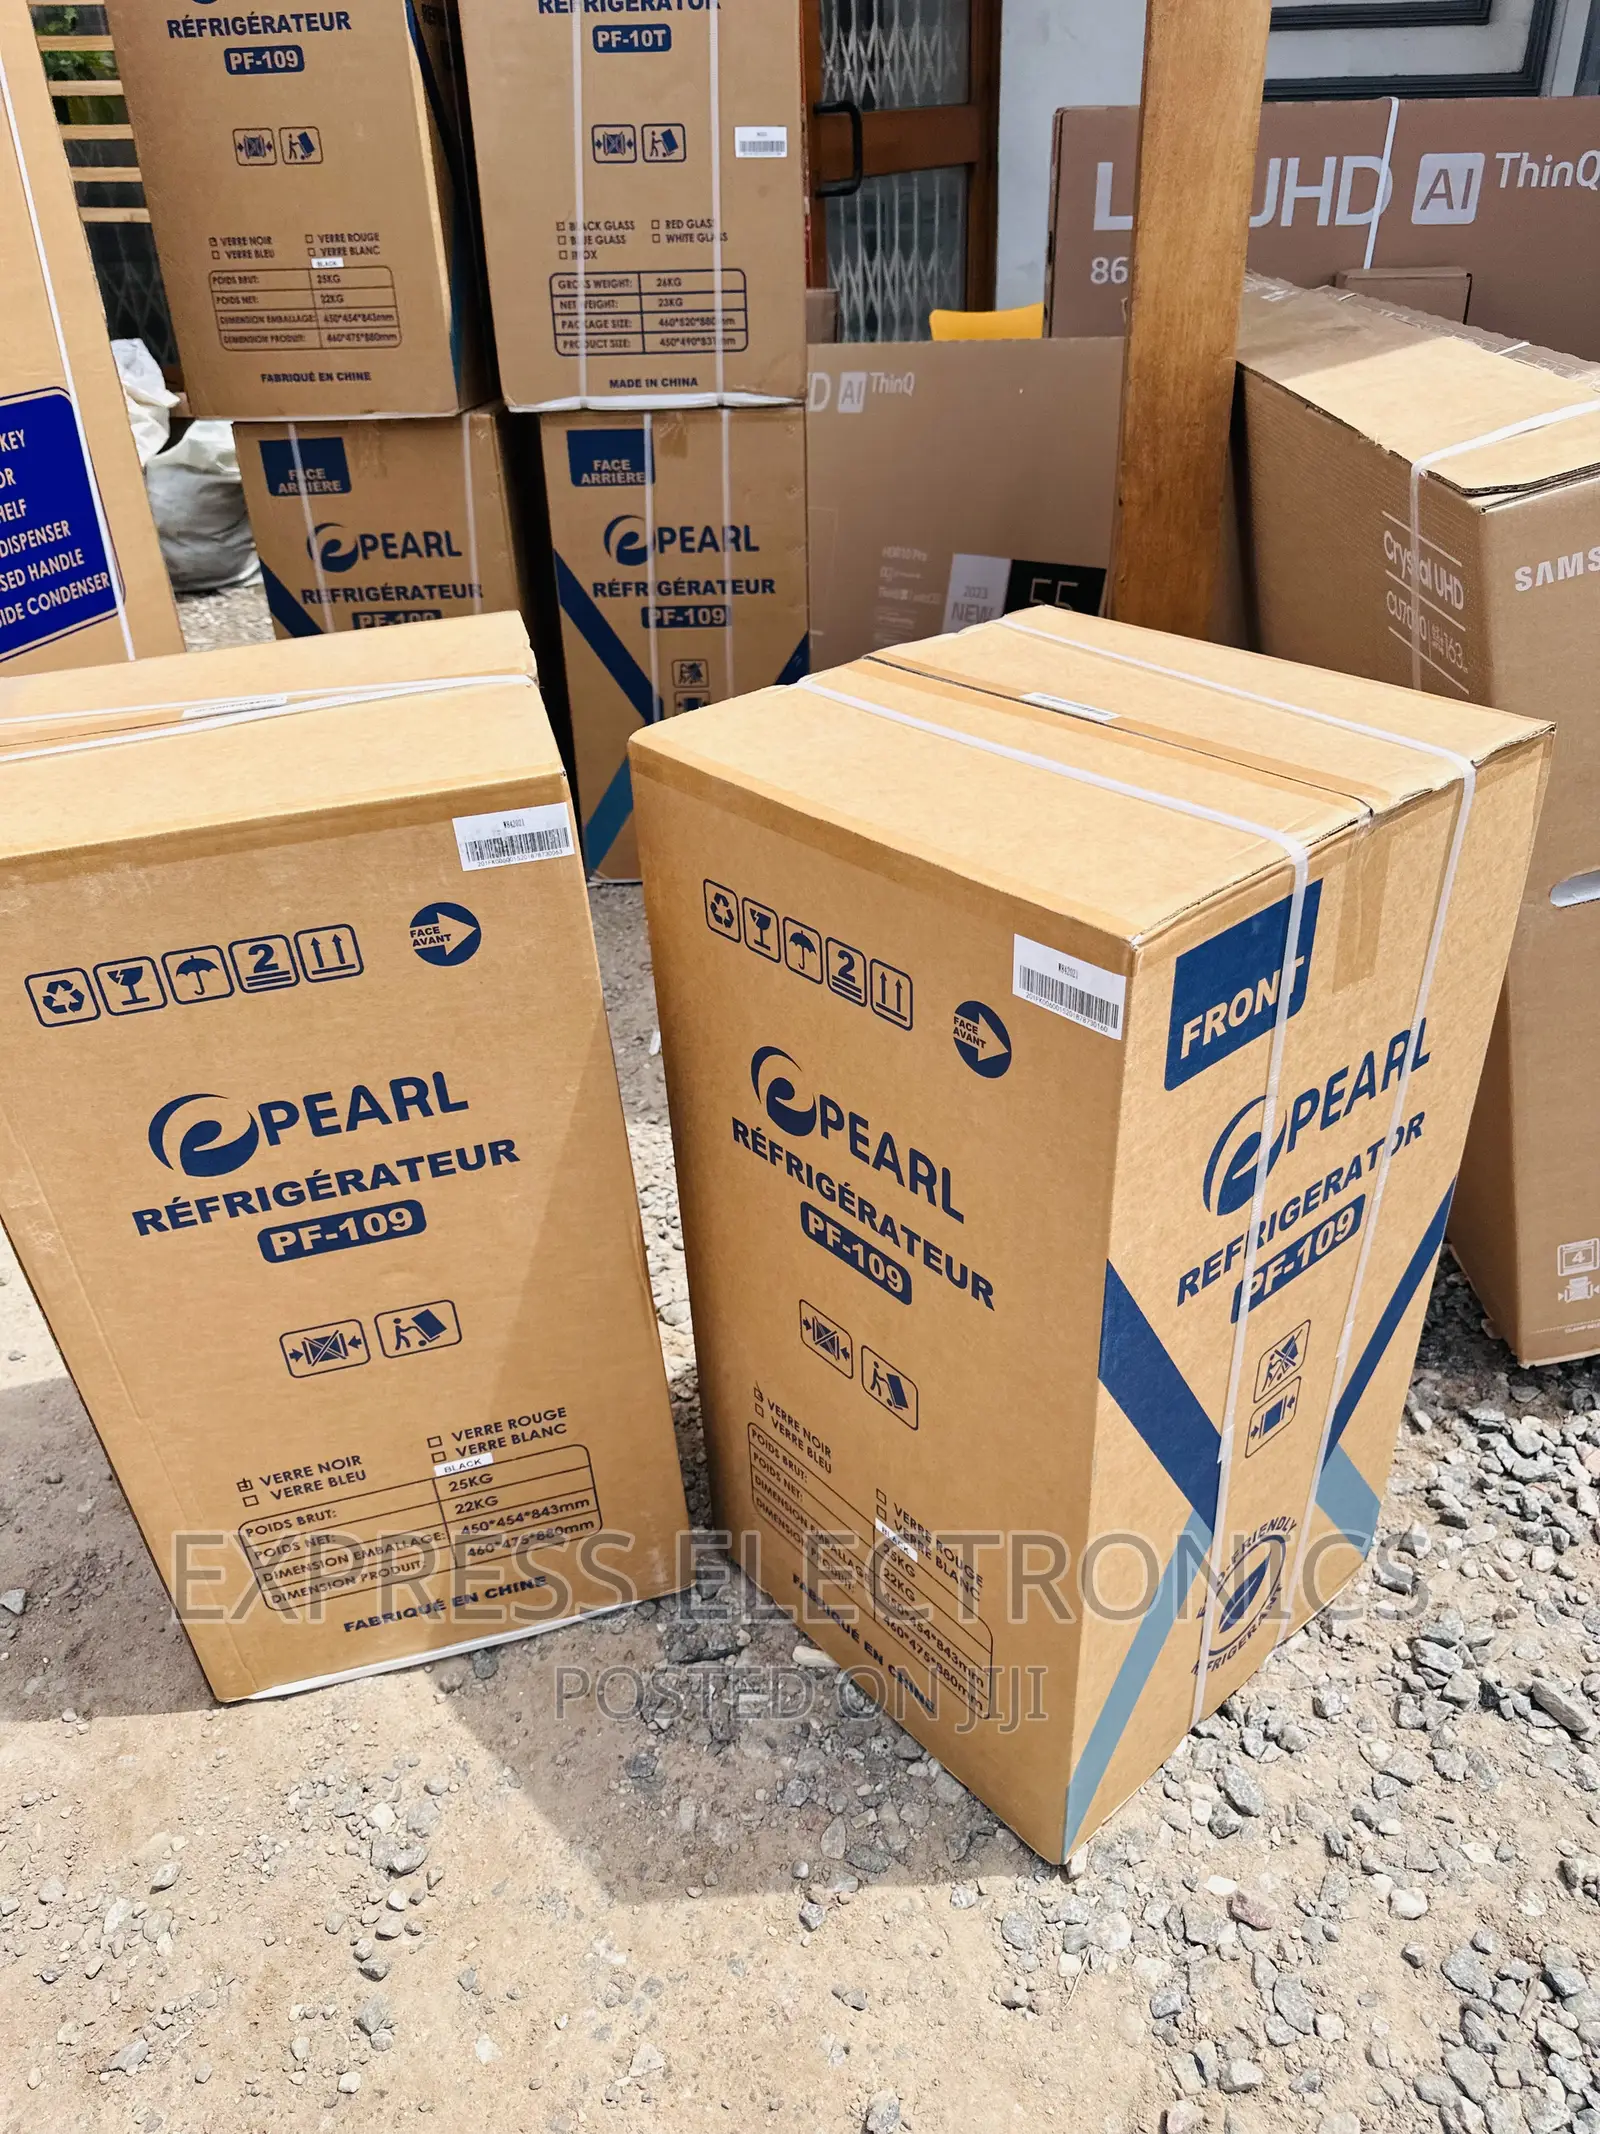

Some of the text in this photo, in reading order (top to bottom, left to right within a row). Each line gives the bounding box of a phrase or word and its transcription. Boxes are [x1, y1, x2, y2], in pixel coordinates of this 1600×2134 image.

[166, 11, 353, 39] RÉFRIGÉRATEUR
[597, 29, 667, 48] PF-10T
[229, 50, 300, 71] PF-109
[1419, 168, 1475, 212] AI
[1494, 150, 1600, 193] ThinQ
[1091, 257, 1129, 285] 86
[318, 372, 334, 383] EN
[336, 372, 372, 382] CHINE
[609, 377, 698, 389] MADE IN CHINA
[869, 371, 916, 397] ThinQ
[593, 459, 631, 471] FACE
[358, 530, 463, 561] PEARL
[27, 548, 85, 581] HANDLE
[26, 572, 110, 615] CONDENSER
[1434, 562, 1464, 611] UHD
[409, 926, 440, 938] FACE
[412, 933, 452, 948] AVANT
[953, 1015, 979, 1035] FACE
[953, 1027, 987, 1049] AVANT
[1286, 1017, 1431, 1154] PEARL
[258, 1070, 469, 1147] PEARL
[820, 1093, 964, 1224] PEARL
[132, 1138, 521, 1237] RÉFRIGÉRATEUR
[732, 1116, 995, 1311] RÉFRIGÉRATEUR
[269, 1207, 413, 1257] PF-109
[807, 1207, 905, 1292] PF-109
[452, 1407, 567, 1443] VERRE ROUGE
[455, 1423, 567, 1458] VERRE BLANC
[767, 1398, 832, 1459] VERRE NOIR
[751, 1428, 808, 1484] POIDS BRUT:
[771, 1416, 832, 1474] VERRE BLEU
[258, 1454, 363, 1488] VERRE NOIR
[444, 1458, 483, 1473] BLACK
[753, 1452, 803, 1502] POIDS NET:
[271, 1470, 367, 1502] VERRE BLEU
[449, 1473, 493, 1493] 25KG
[455, 1495, 499, 1515] 22KG
[754, 1475, 809, 1528] DIMENSION
[246, 1509, 338, 1537] POIDS BRUT:
[254, 1542, 301, 1560] POIDS
[883, 1543, 916, 1578] 25KG
[894, 1502, 983, 1589] VERRE ROUGE
[894, 1520, 981, 1602] VERRE BLANC
[263, 1554, 349, 1582] DIMENSION
[883, 1567, 916, 1602] 22KG
[271, 1575, 356, 1604] DIMENSION
[343, 1576, 548, 1633] FABRIQUÉ EN CHINE
[864, 1641, 884, 1666] EN
